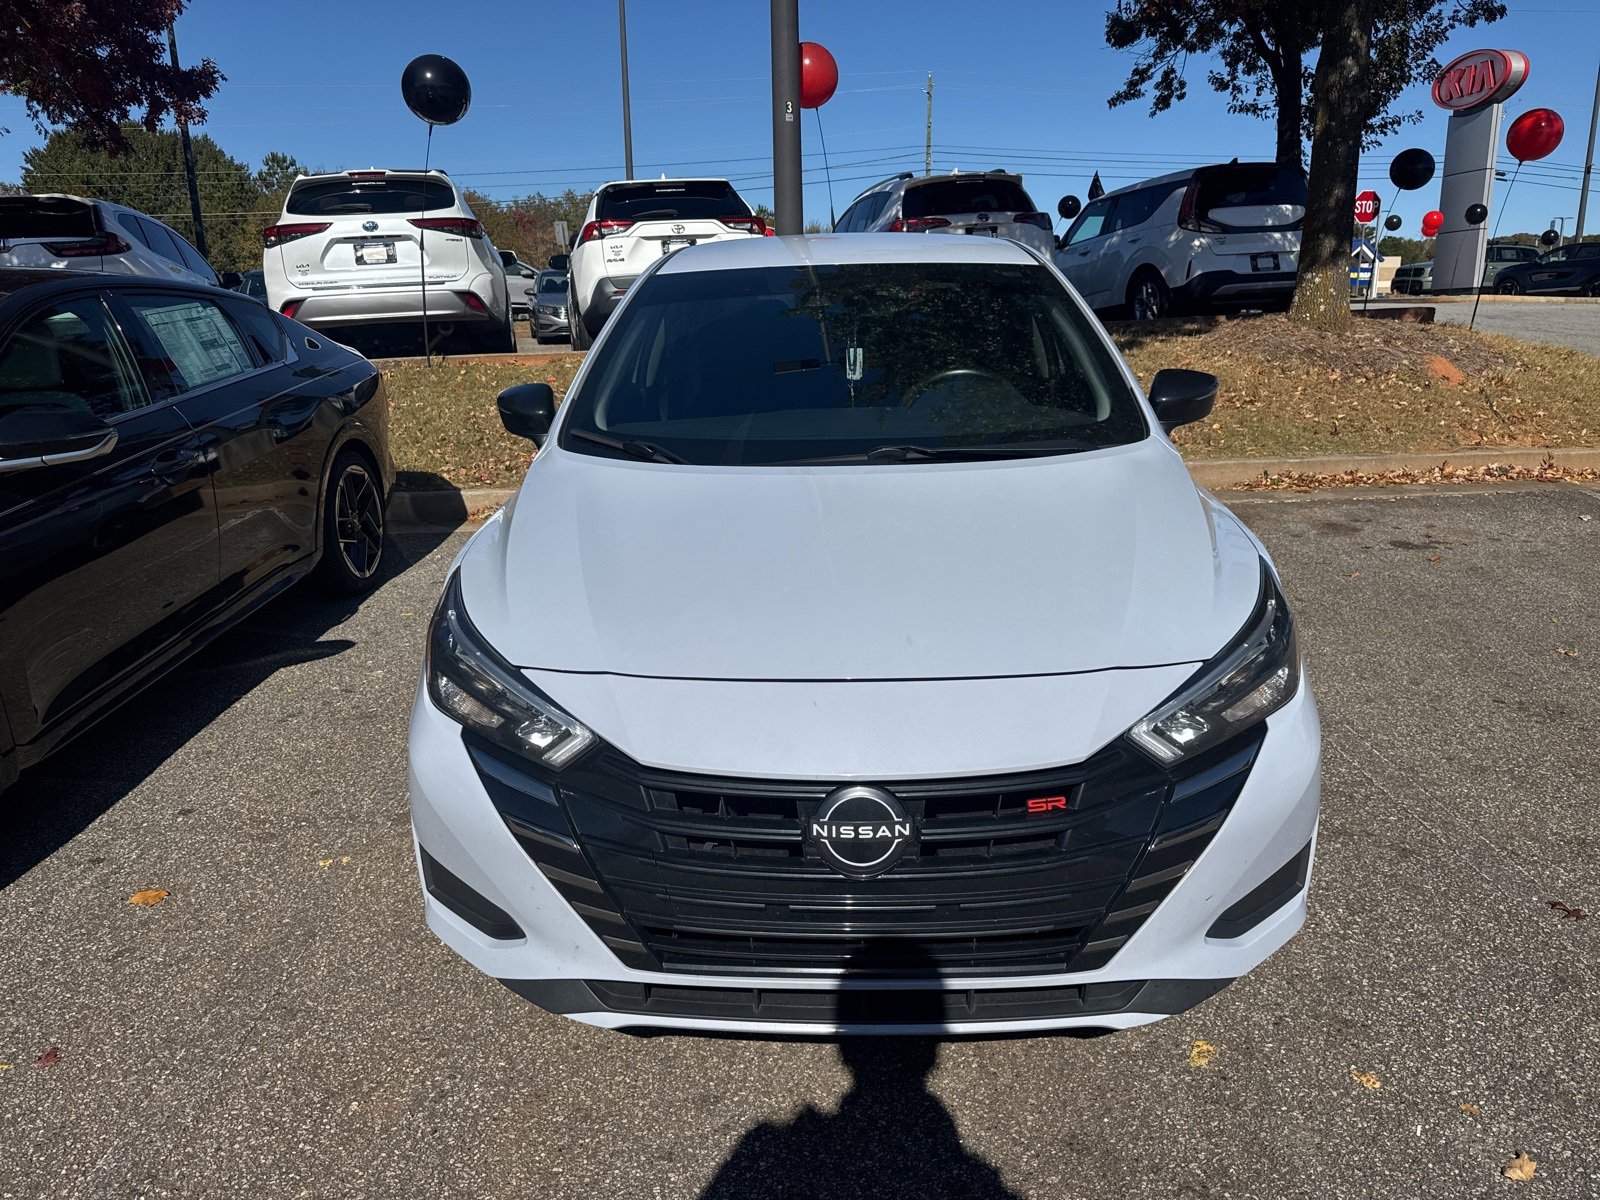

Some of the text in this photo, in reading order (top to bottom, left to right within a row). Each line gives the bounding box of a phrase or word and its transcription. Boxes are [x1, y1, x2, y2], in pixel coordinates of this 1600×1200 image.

[1443, 59, 1496, 102] KIA
[786, 101, 793, 113] 3
[1354, 201, 1379, 213] STOP
[1027, 796, 1067, 813] SR
[812, 823, 910, 839] NISSAN
